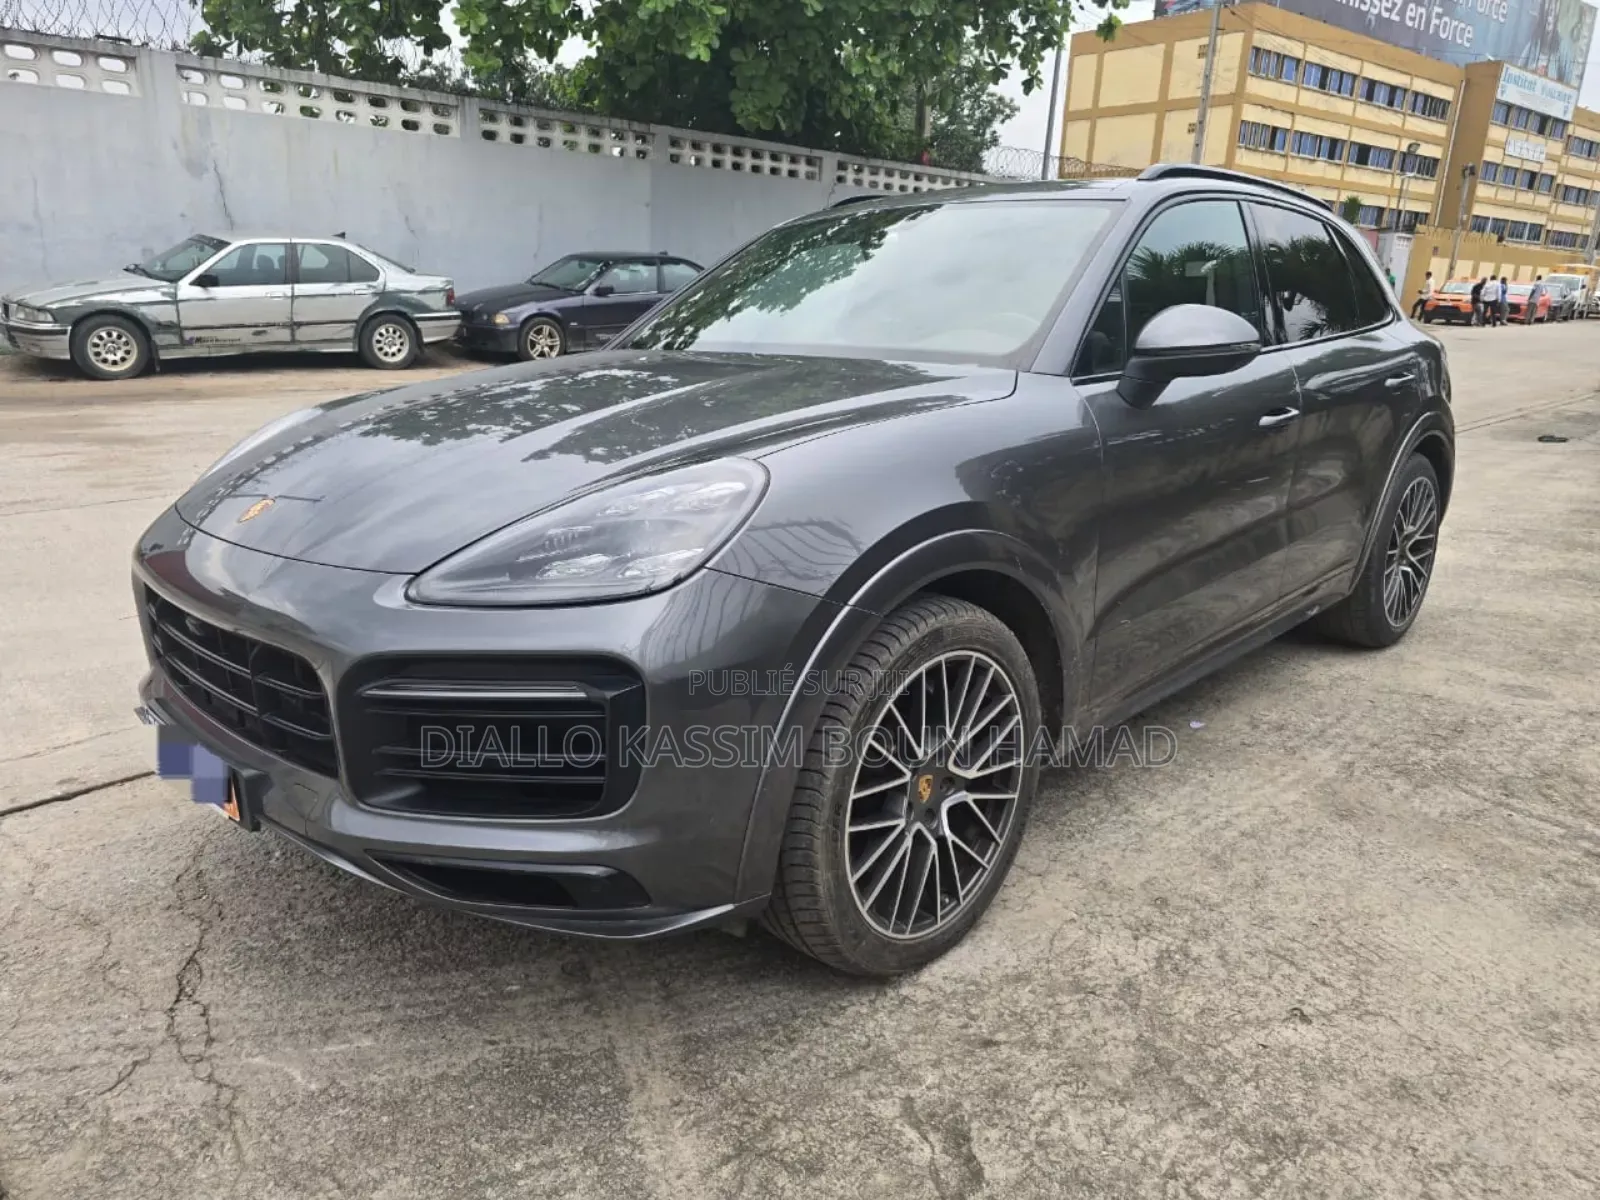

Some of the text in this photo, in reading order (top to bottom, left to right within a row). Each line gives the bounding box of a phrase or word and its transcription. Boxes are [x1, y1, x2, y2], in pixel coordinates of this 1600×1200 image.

[1405, 2, 1426, 31] en
[1429, 5, 1474, 48] Force
[1467, 0, 1508, 23] orce
